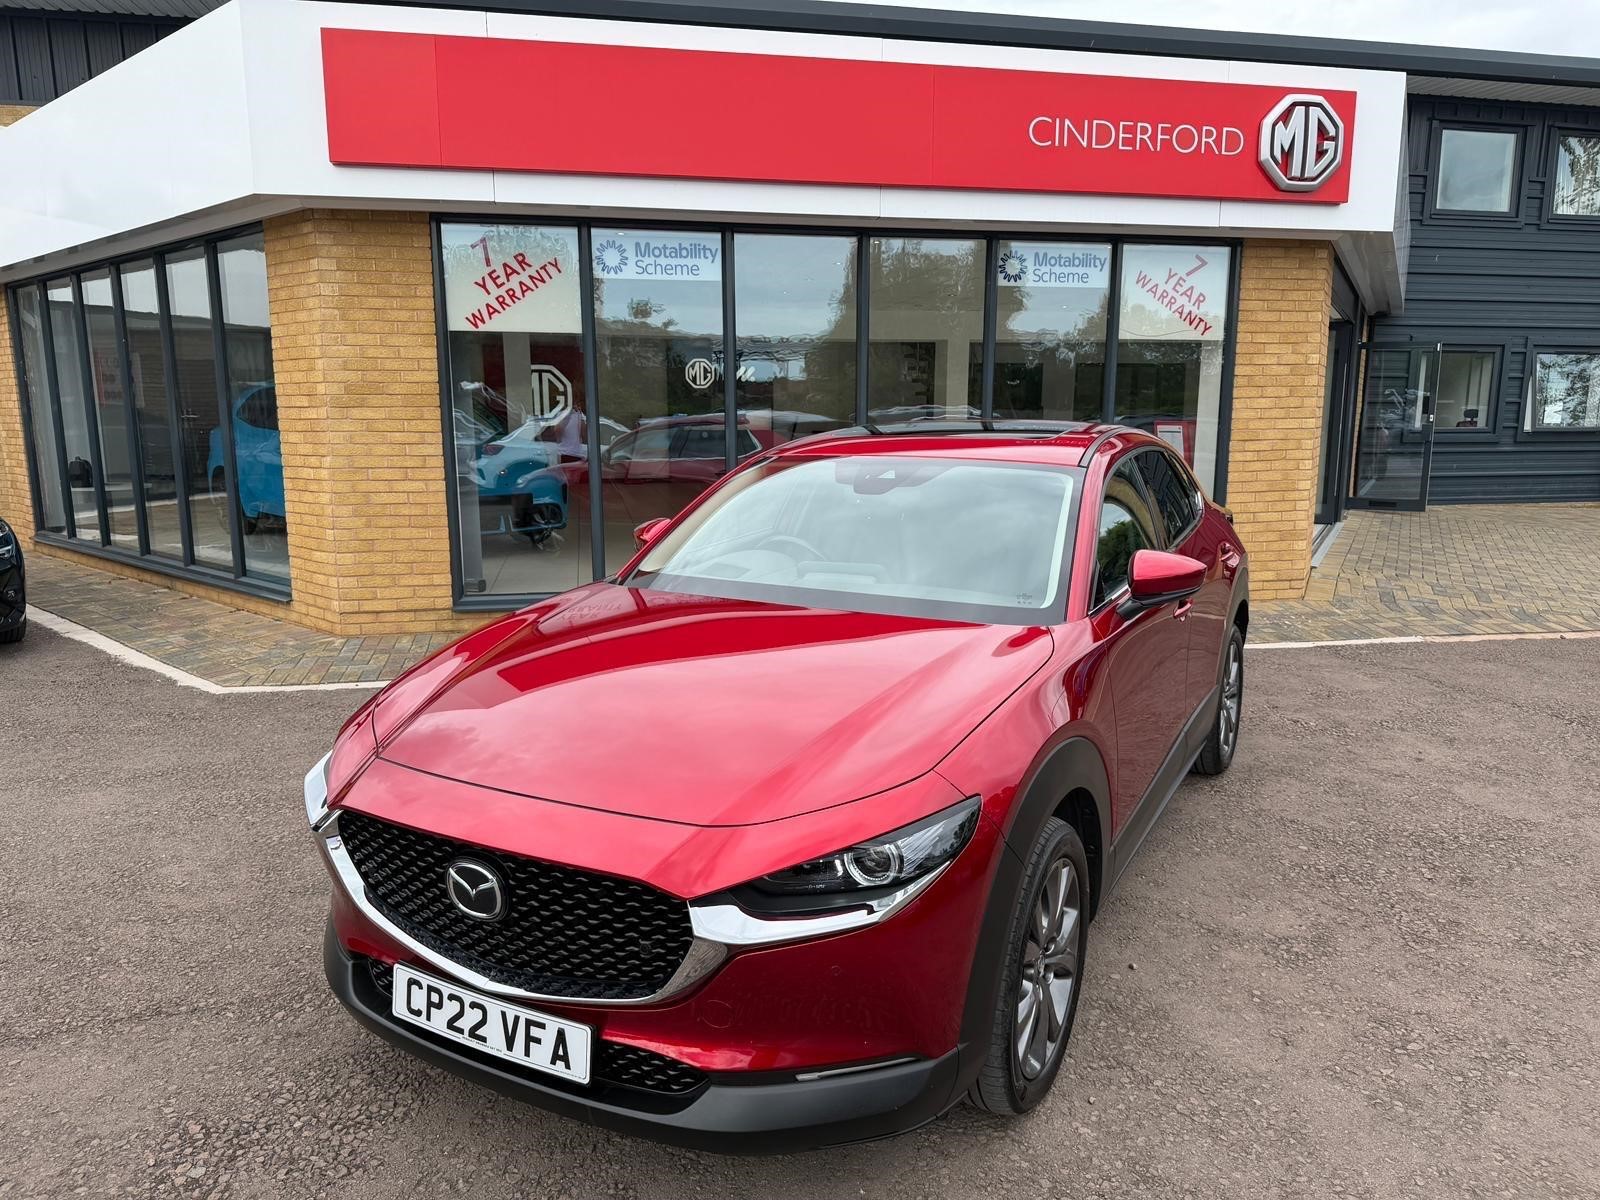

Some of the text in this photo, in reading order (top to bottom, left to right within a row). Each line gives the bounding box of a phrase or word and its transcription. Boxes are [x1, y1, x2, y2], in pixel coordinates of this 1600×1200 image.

[1029, 116, 1244, 156] CINDERFORD
[1272, 101, 1339, 183] MG
[470, 236, 491, 267] 7
[635, 241, 718, 263] Motability
[635, 260, 700, 276] Scheme
[1033, 251, 1108, 272] Motability
[1185, 254, 1208, 277] 7
[474, 252, 532, 295] YEAR
[1032, 268, 1089, 283] Scheme
[1165, 267, 1206, 310] YEAR
[465, 257, 562, 329] WARRANTY
[1136, 270, 1212, 336] WARRANTY
[688, 360, 712, 386] MG
[406, 977, 571, 1070] CP22 VFA
